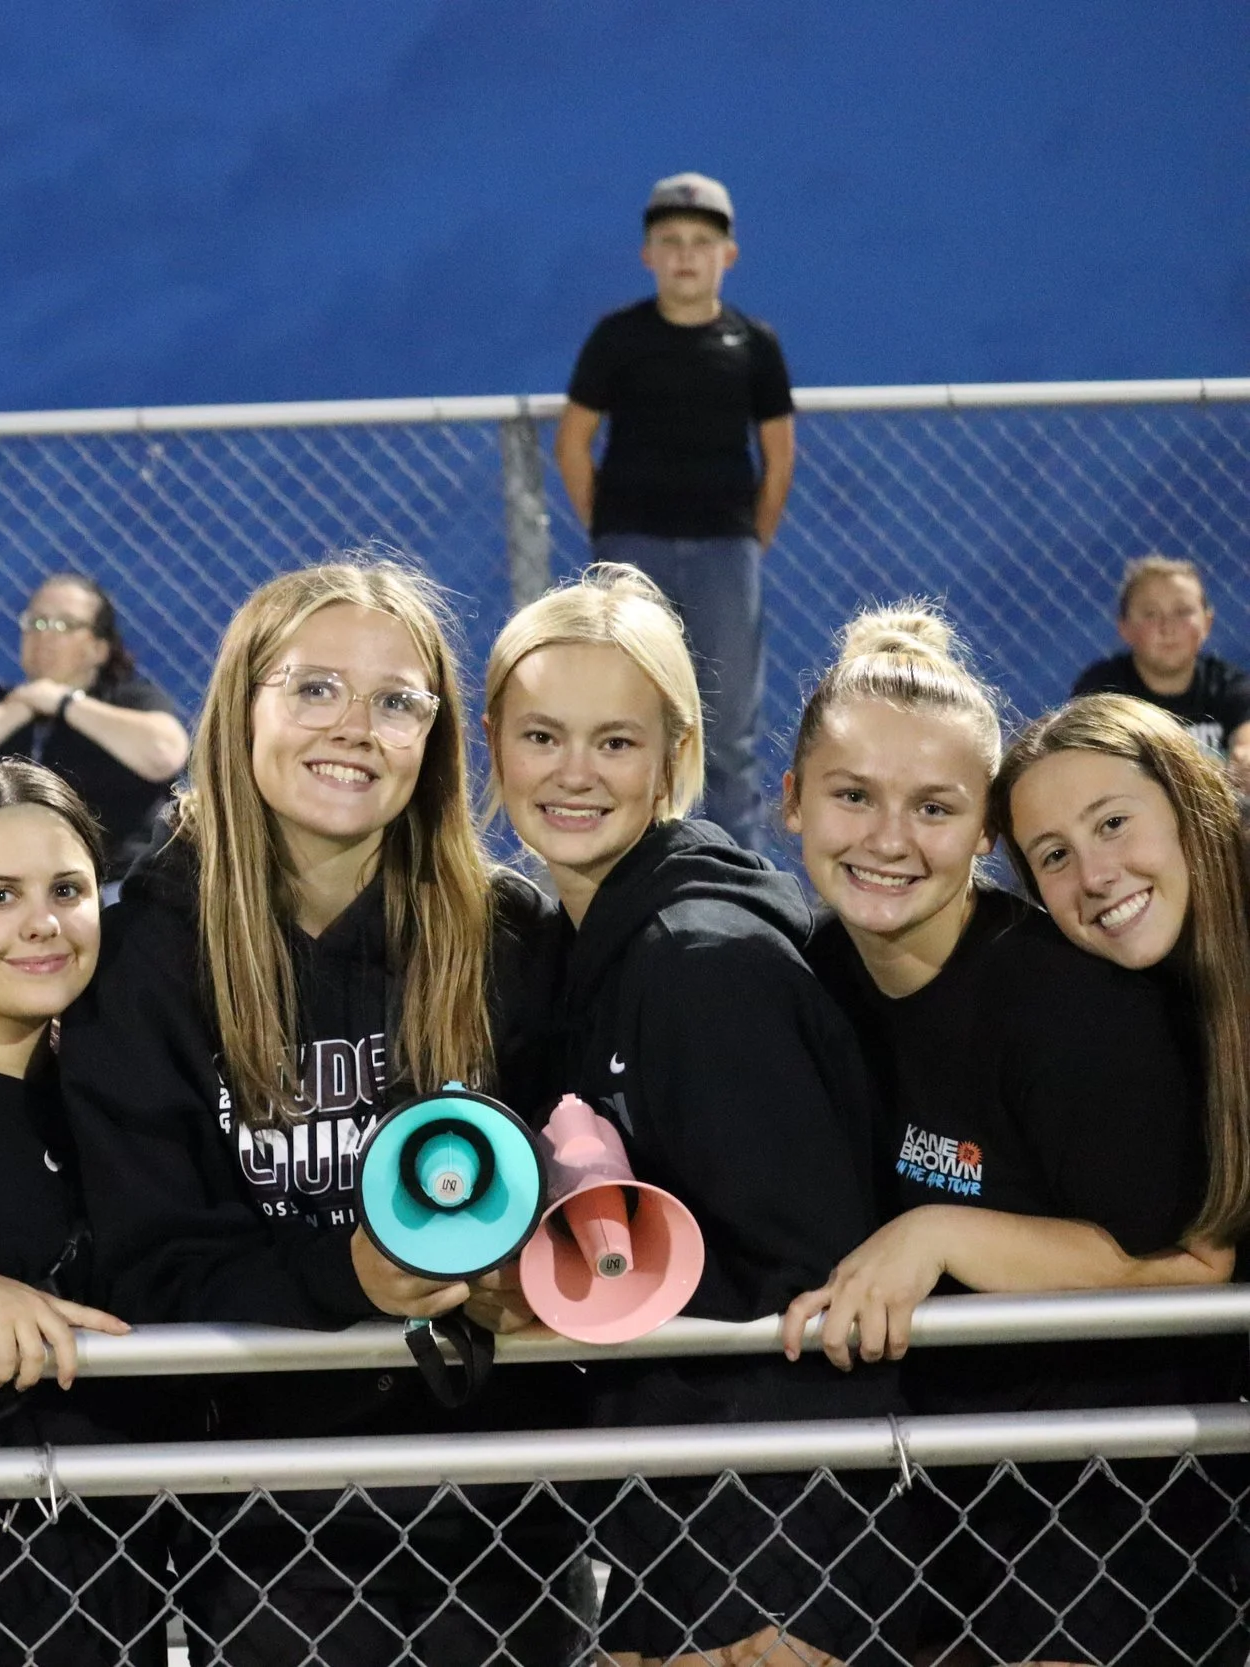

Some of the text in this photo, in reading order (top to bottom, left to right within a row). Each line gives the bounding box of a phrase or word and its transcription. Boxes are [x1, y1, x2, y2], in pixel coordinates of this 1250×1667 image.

[905, 1123, 959, 1160] KANE
[899, 1141, 983, 1182] BROWN
[906, 1164, 927, 1182] THE
[947, 1176, 982, 1197] TOUR
